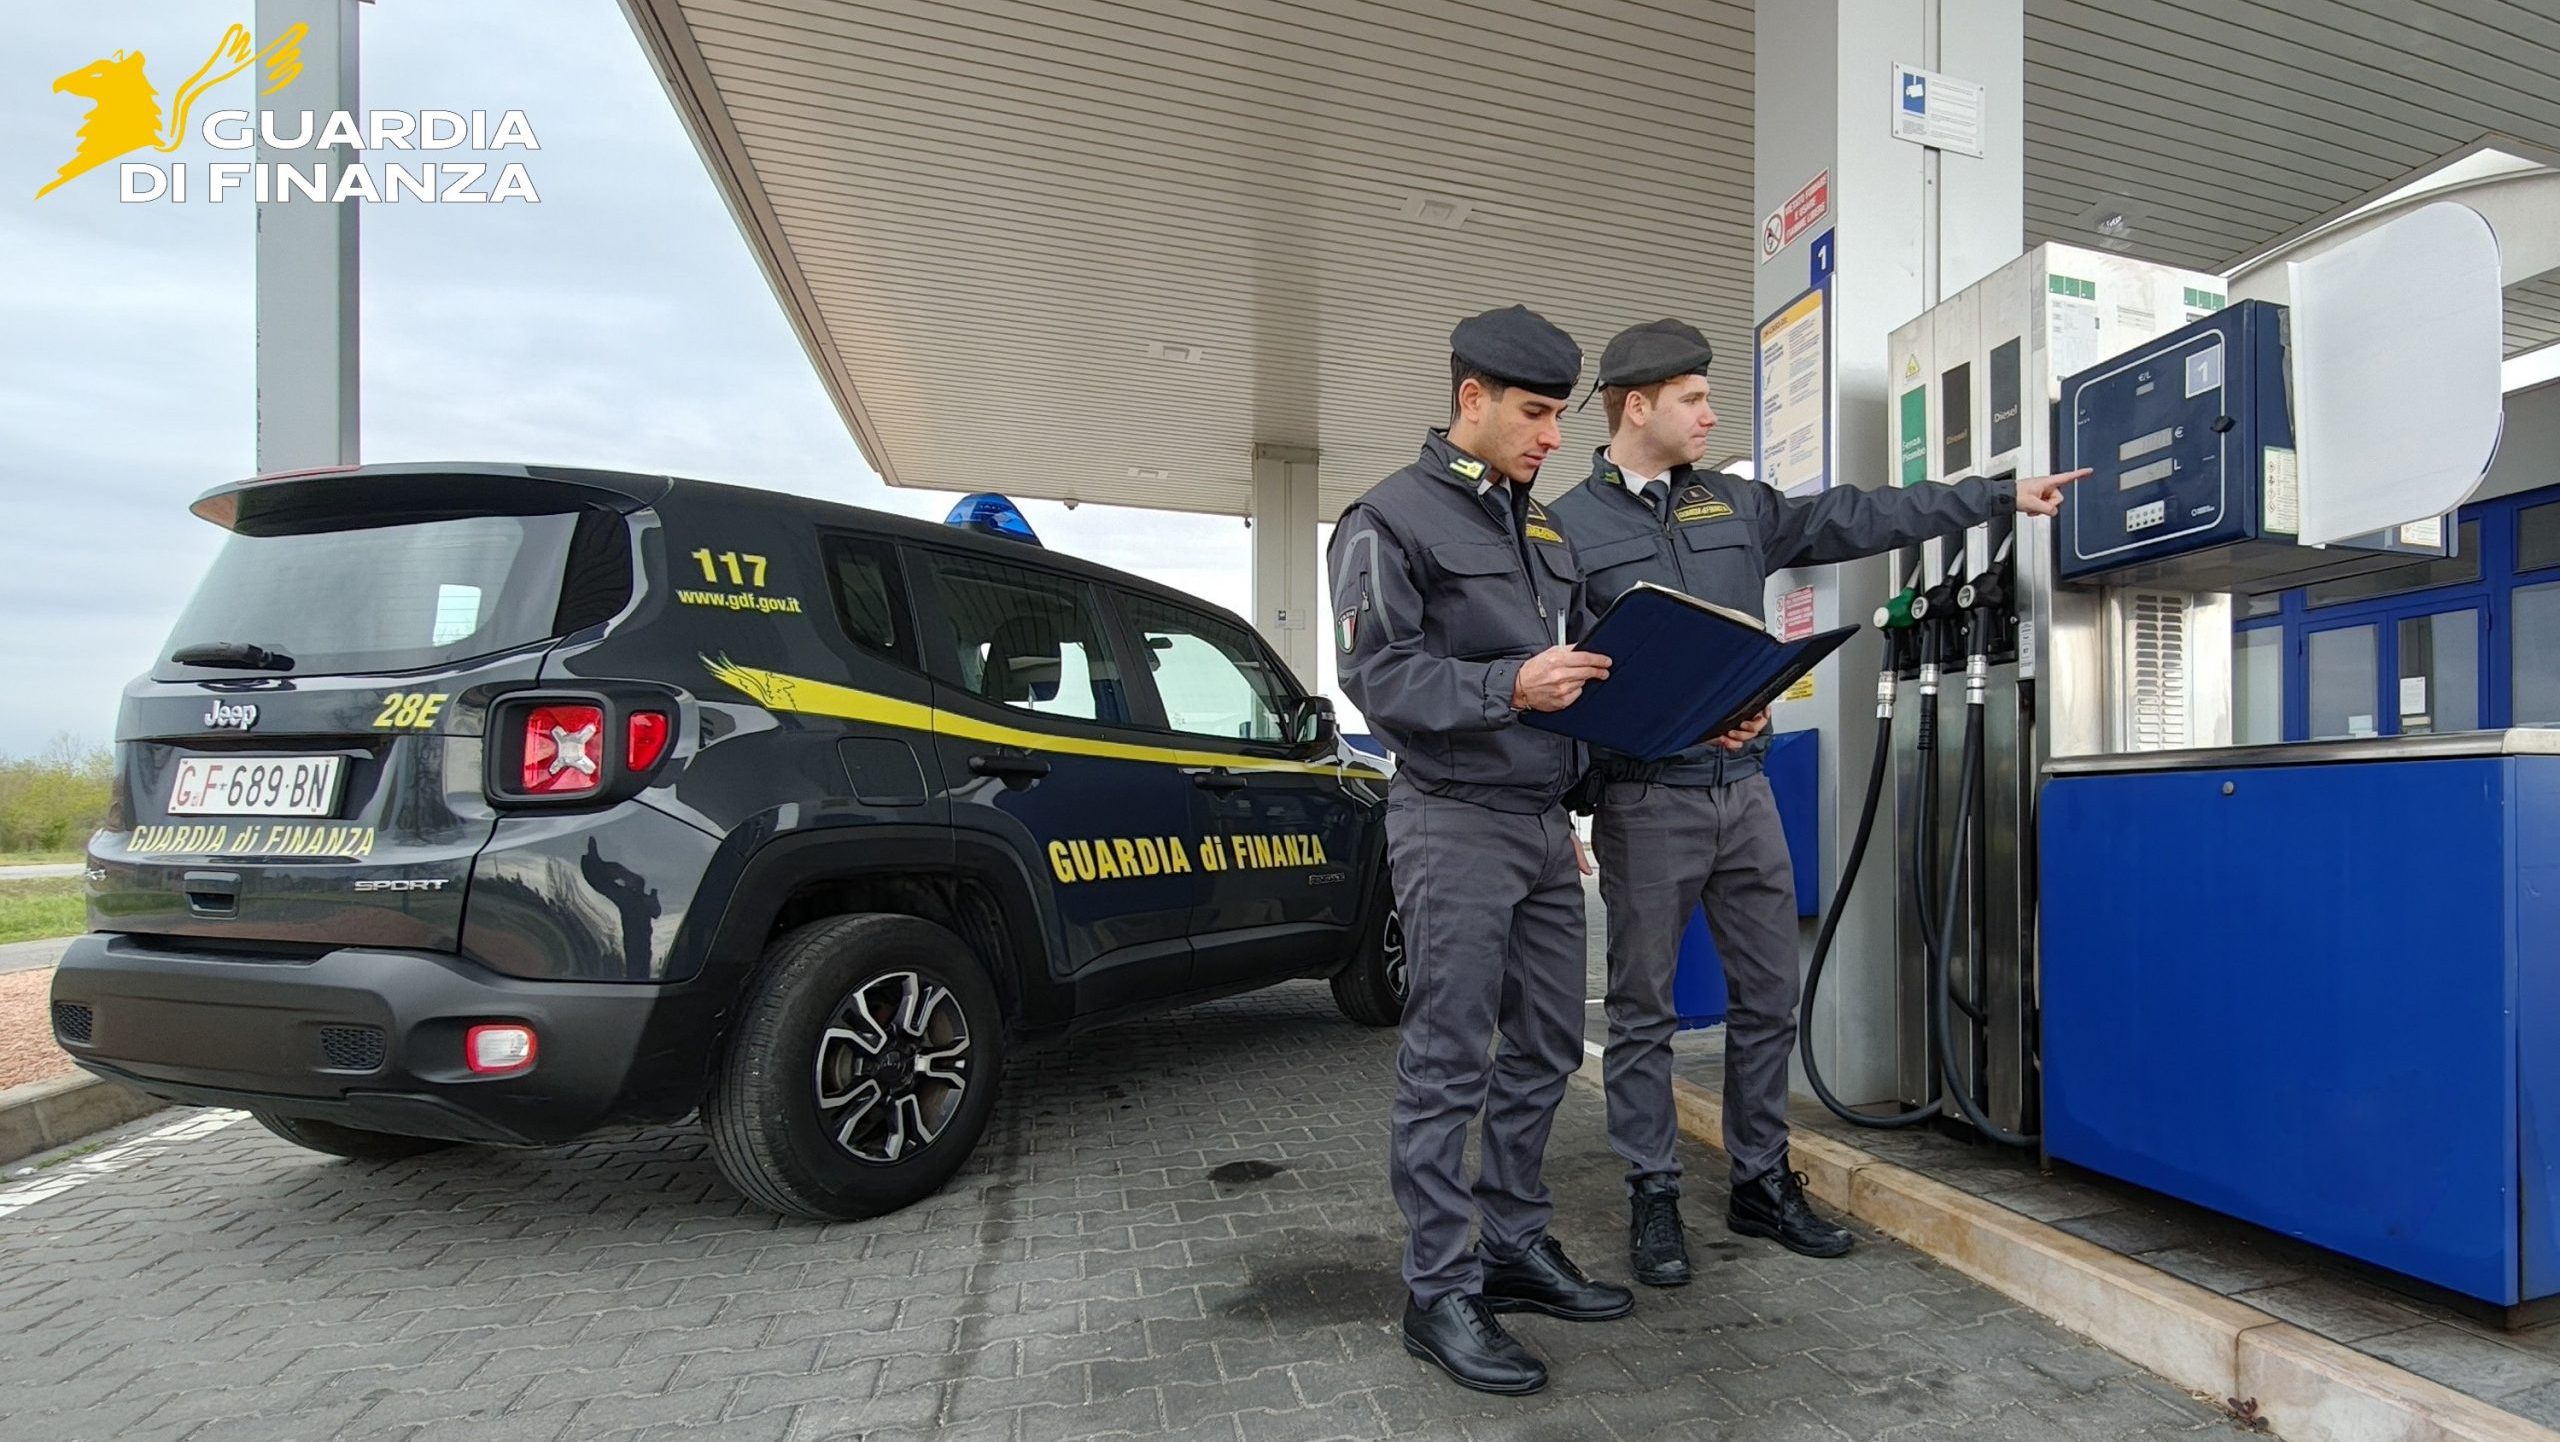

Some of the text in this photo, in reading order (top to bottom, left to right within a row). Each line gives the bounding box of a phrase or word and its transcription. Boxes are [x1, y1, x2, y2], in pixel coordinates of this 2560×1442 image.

[1817, 244, 1827, 271] 1
[2197, 360, 2209, 383] 1
[1993, 404, 2018, 423] Diesel
[2173, 458, 2182, 471] L
[690, 547, 768, 588] 117
[675, 588, 803, 614] www.gdf.gov.it
[204, 699, 258, 731] Jeep
[372, 692, 450, 728] 28E
[126, 824, 376, 857] GUARDIA di FINANZA
[1047, 833, 1328, 884] GUARDIA di FINANZA
[354, 879, 450, 892] SPORT
